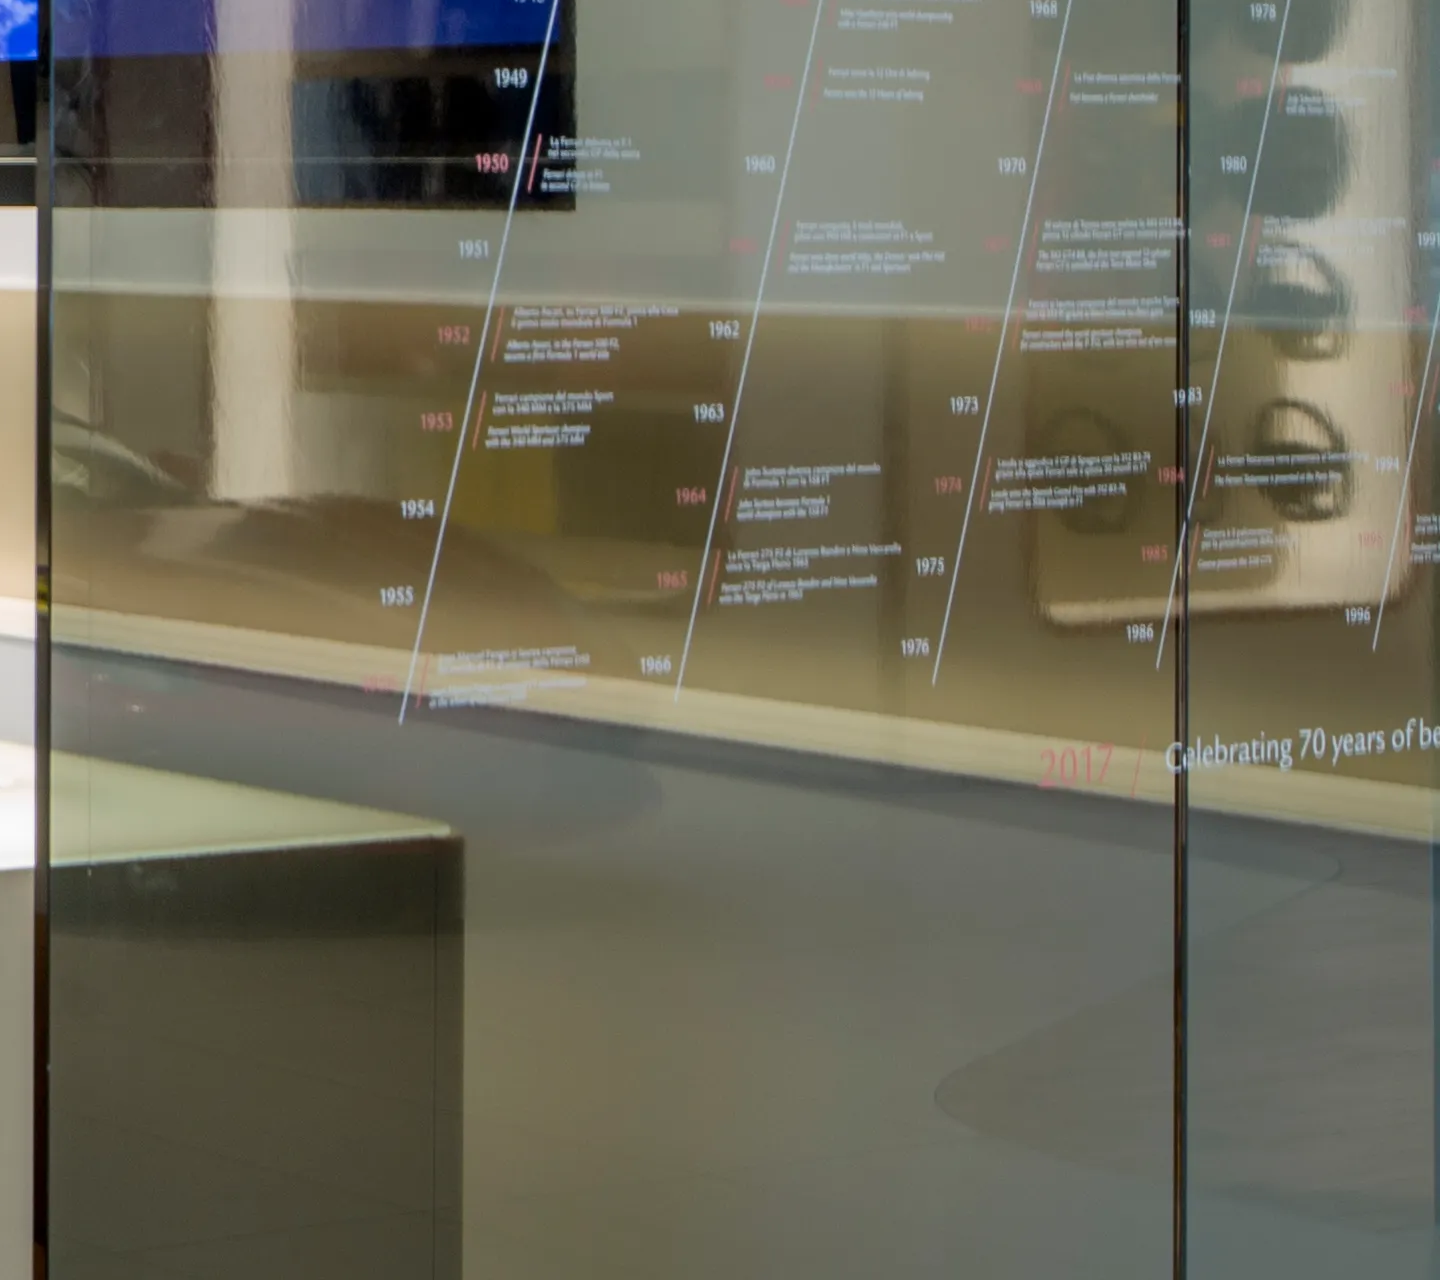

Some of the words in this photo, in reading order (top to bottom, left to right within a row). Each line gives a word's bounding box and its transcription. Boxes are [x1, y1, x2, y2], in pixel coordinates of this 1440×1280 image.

[1029, 0, 1058, 18] 1968
[1249, 3, 1277, 22] 1978
[494, 67, 528, 89] 1949
[475, 152, 509, 173] 1950
[744, 154, 775, 172] 1960
[997, 157, 1026, 174] 1970
[1220, 155, 1248, 174] 1980
[458, 239, 489, 259] 1951
[1189, 308, 1216, 327] 1982
[437, 325, 470, 344] 1952
[709, 320, 740, 340] 1962
[694, 403, 725, 422] 1963
[950, 397, 979, 415] 1973
[420, 412, 453, 431] 1953
[934, 476, 963, 494] 1974
[674, 487, 707, 504] 1964
[400, 499, 435, 518] 1954
[1140, 545, 1168, 562] 1985
[916, 557, 945, 575] 1975
[656, 571, 688, 589] 1965
[380, 587, 414, 606] 1955
[1344, 606, 1371, 625] 1996
[1125, 624, 1154, 642] 1986
[901, 639, 930, 657] 1976
[640, 656, 672, 674] 1966
[1165, 730, 1293, 773] Celebrating
[1299, 727, 1326, 761] 70
[1332, 729, 1385, 767] years
[1392, 718, 1417, 751] of
[1039, 743, 1115, 789] 2017
